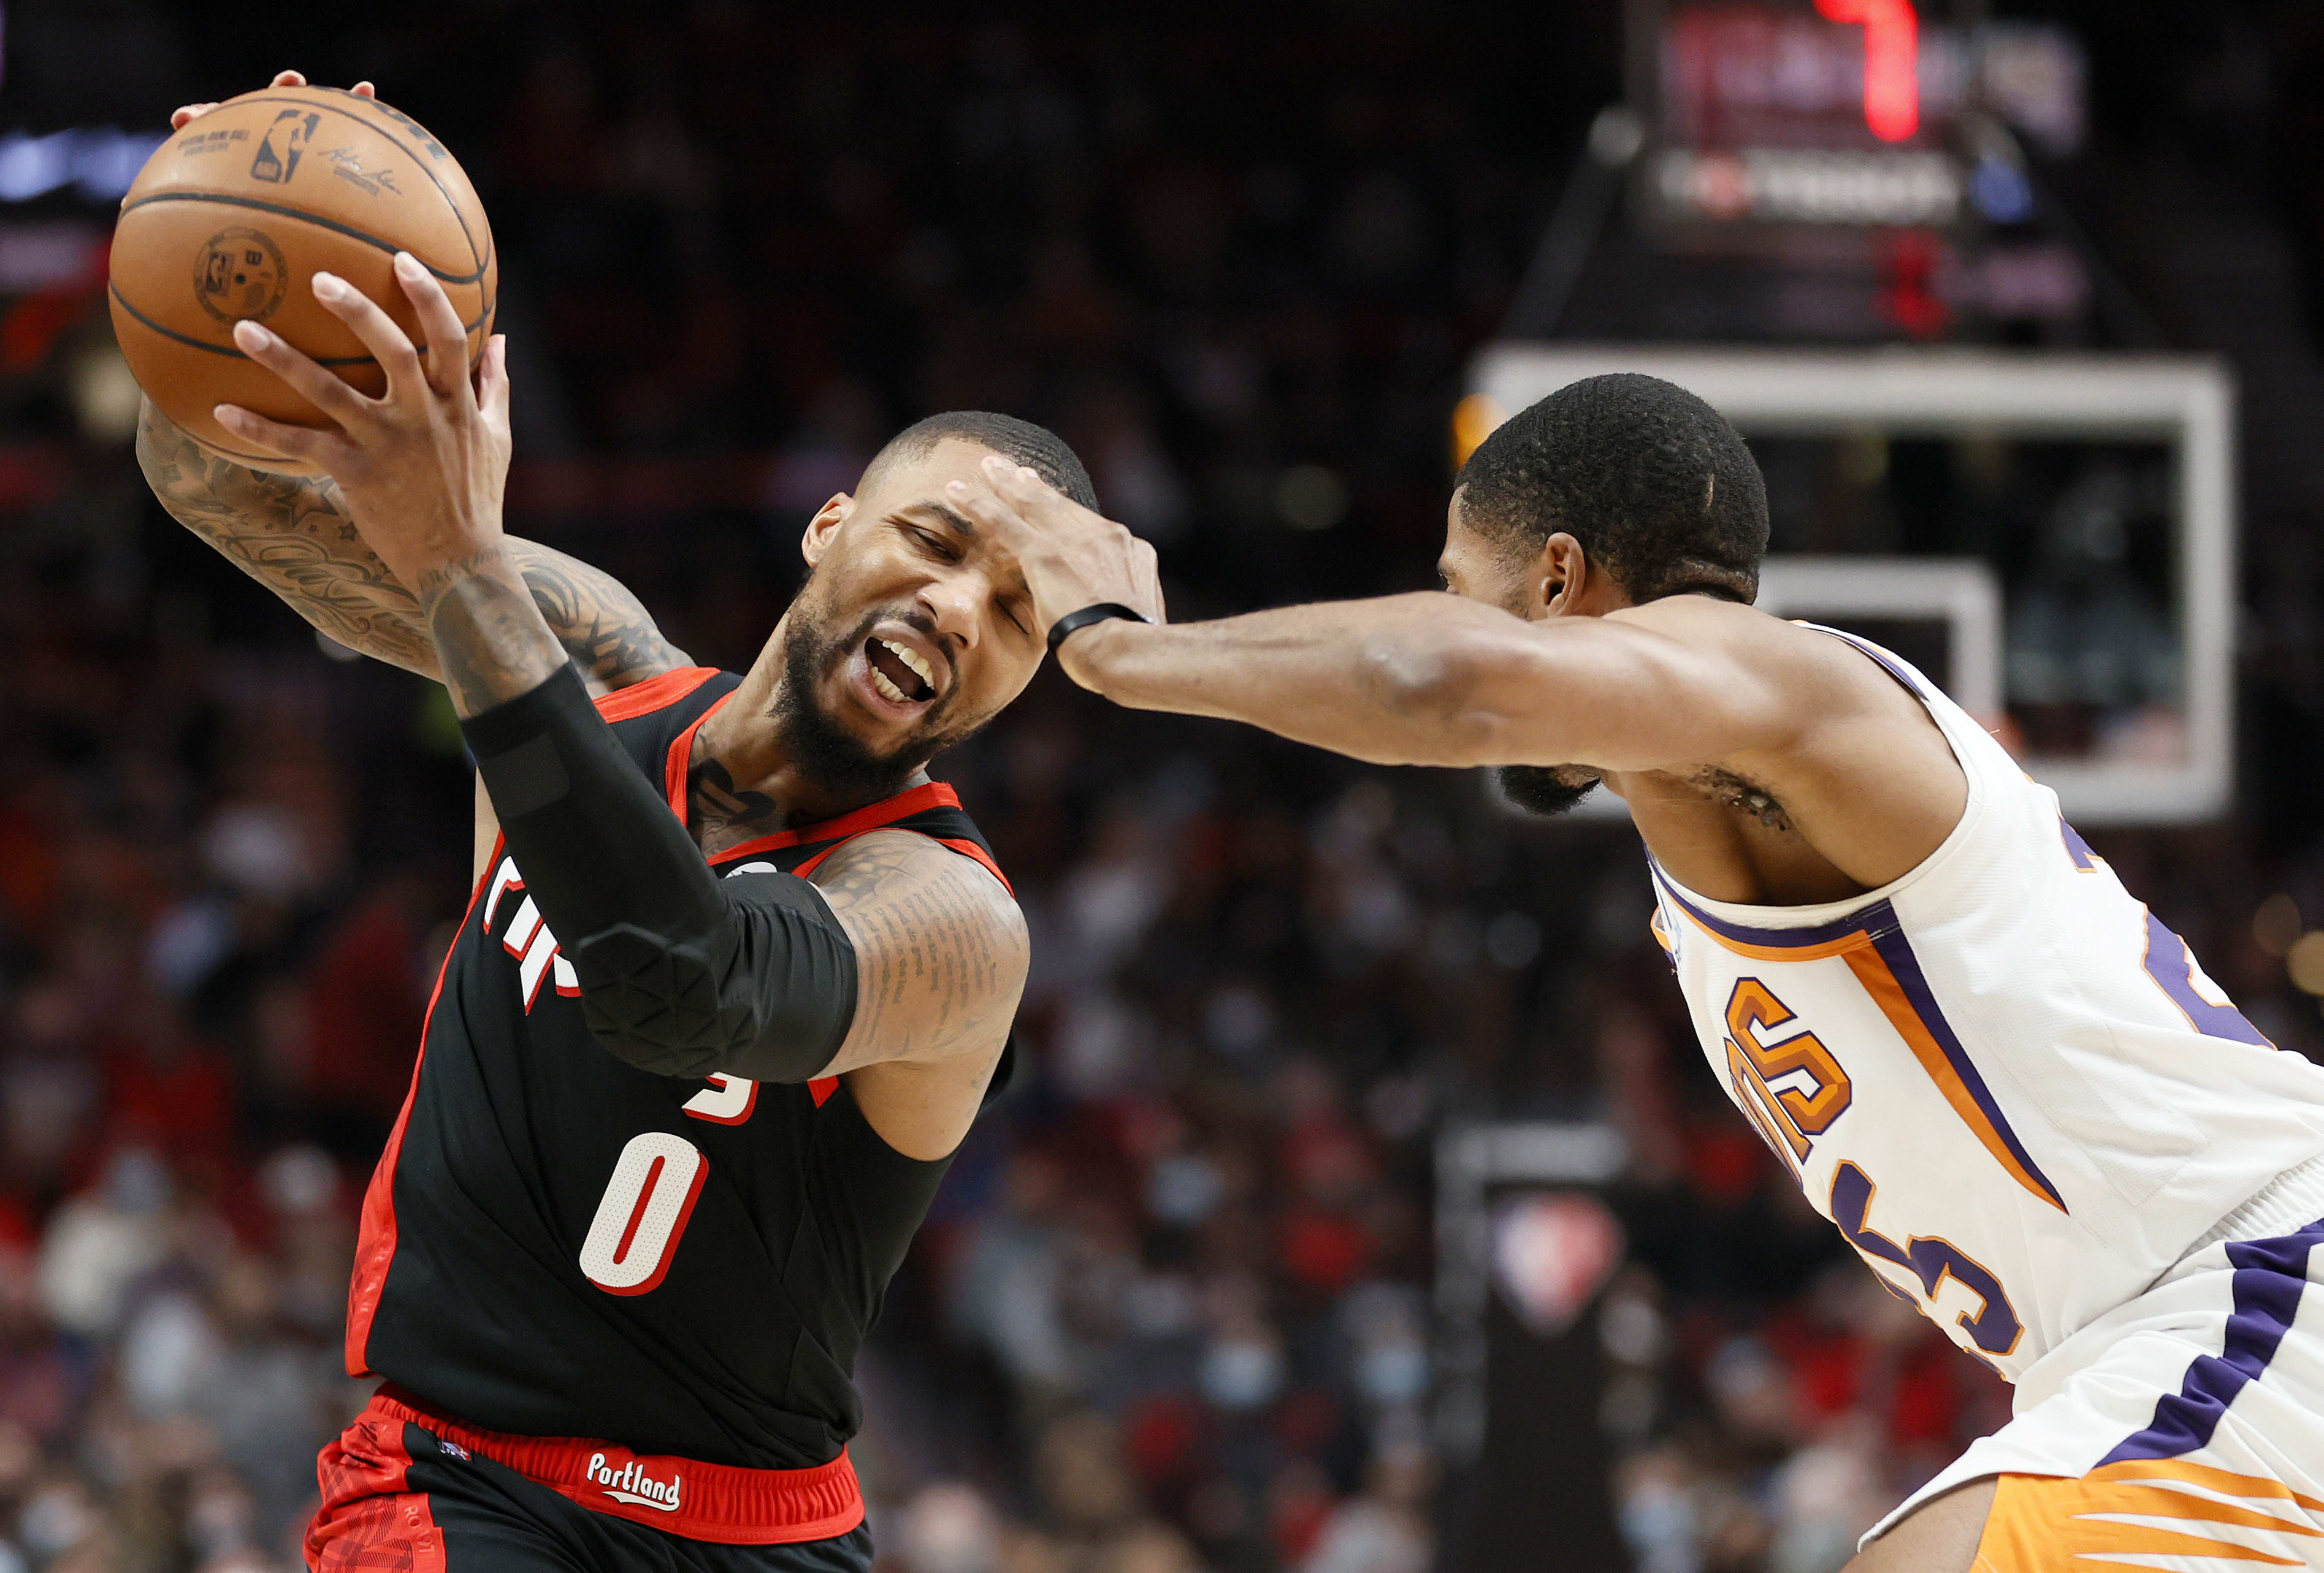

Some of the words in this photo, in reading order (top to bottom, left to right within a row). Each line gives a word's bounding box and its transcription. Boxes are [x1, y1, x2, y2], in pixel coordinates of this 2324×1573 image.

[579, 1132, 709, 1297] 0
[1826, 1159, 2025, 1382] 5
[586, 1452, 681, 1507] Portland
